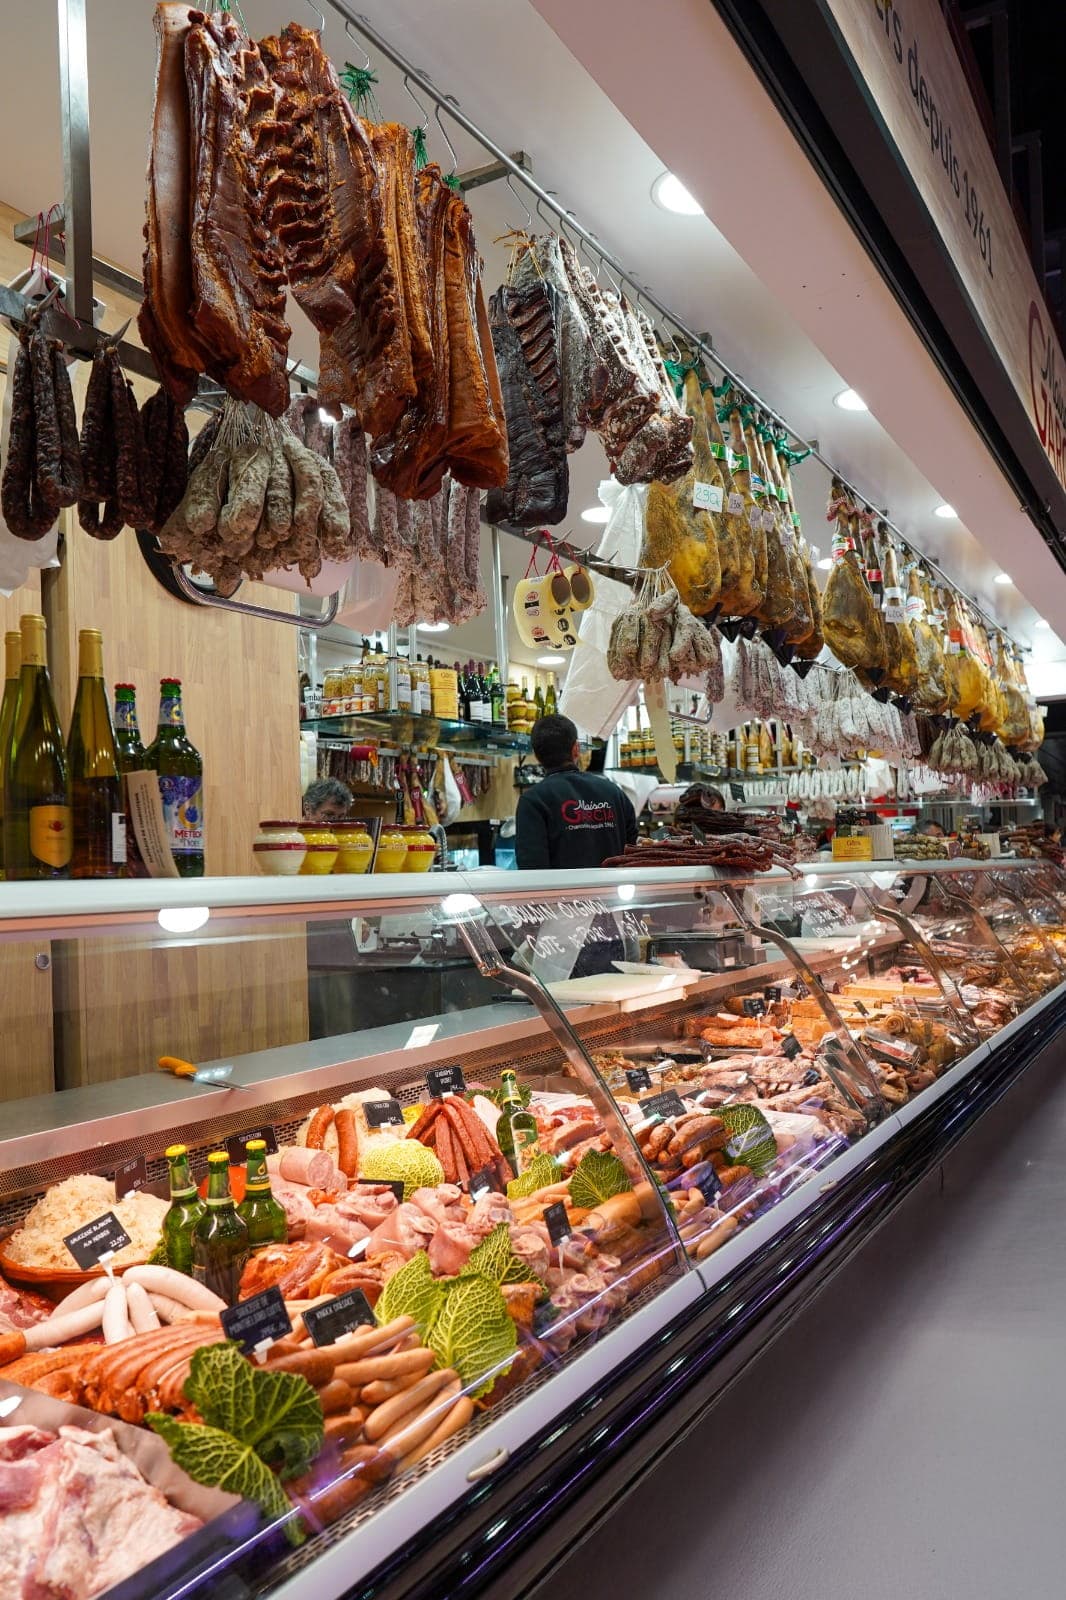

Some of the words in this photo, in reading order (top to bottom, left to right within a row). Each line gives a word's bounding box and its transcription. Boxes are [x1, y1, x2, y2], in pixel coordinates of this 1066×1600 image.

[907, 39, 960, 199] depuis
[963, 170, 994, 280] 1961
[573, 799, 612, 811] Maison
